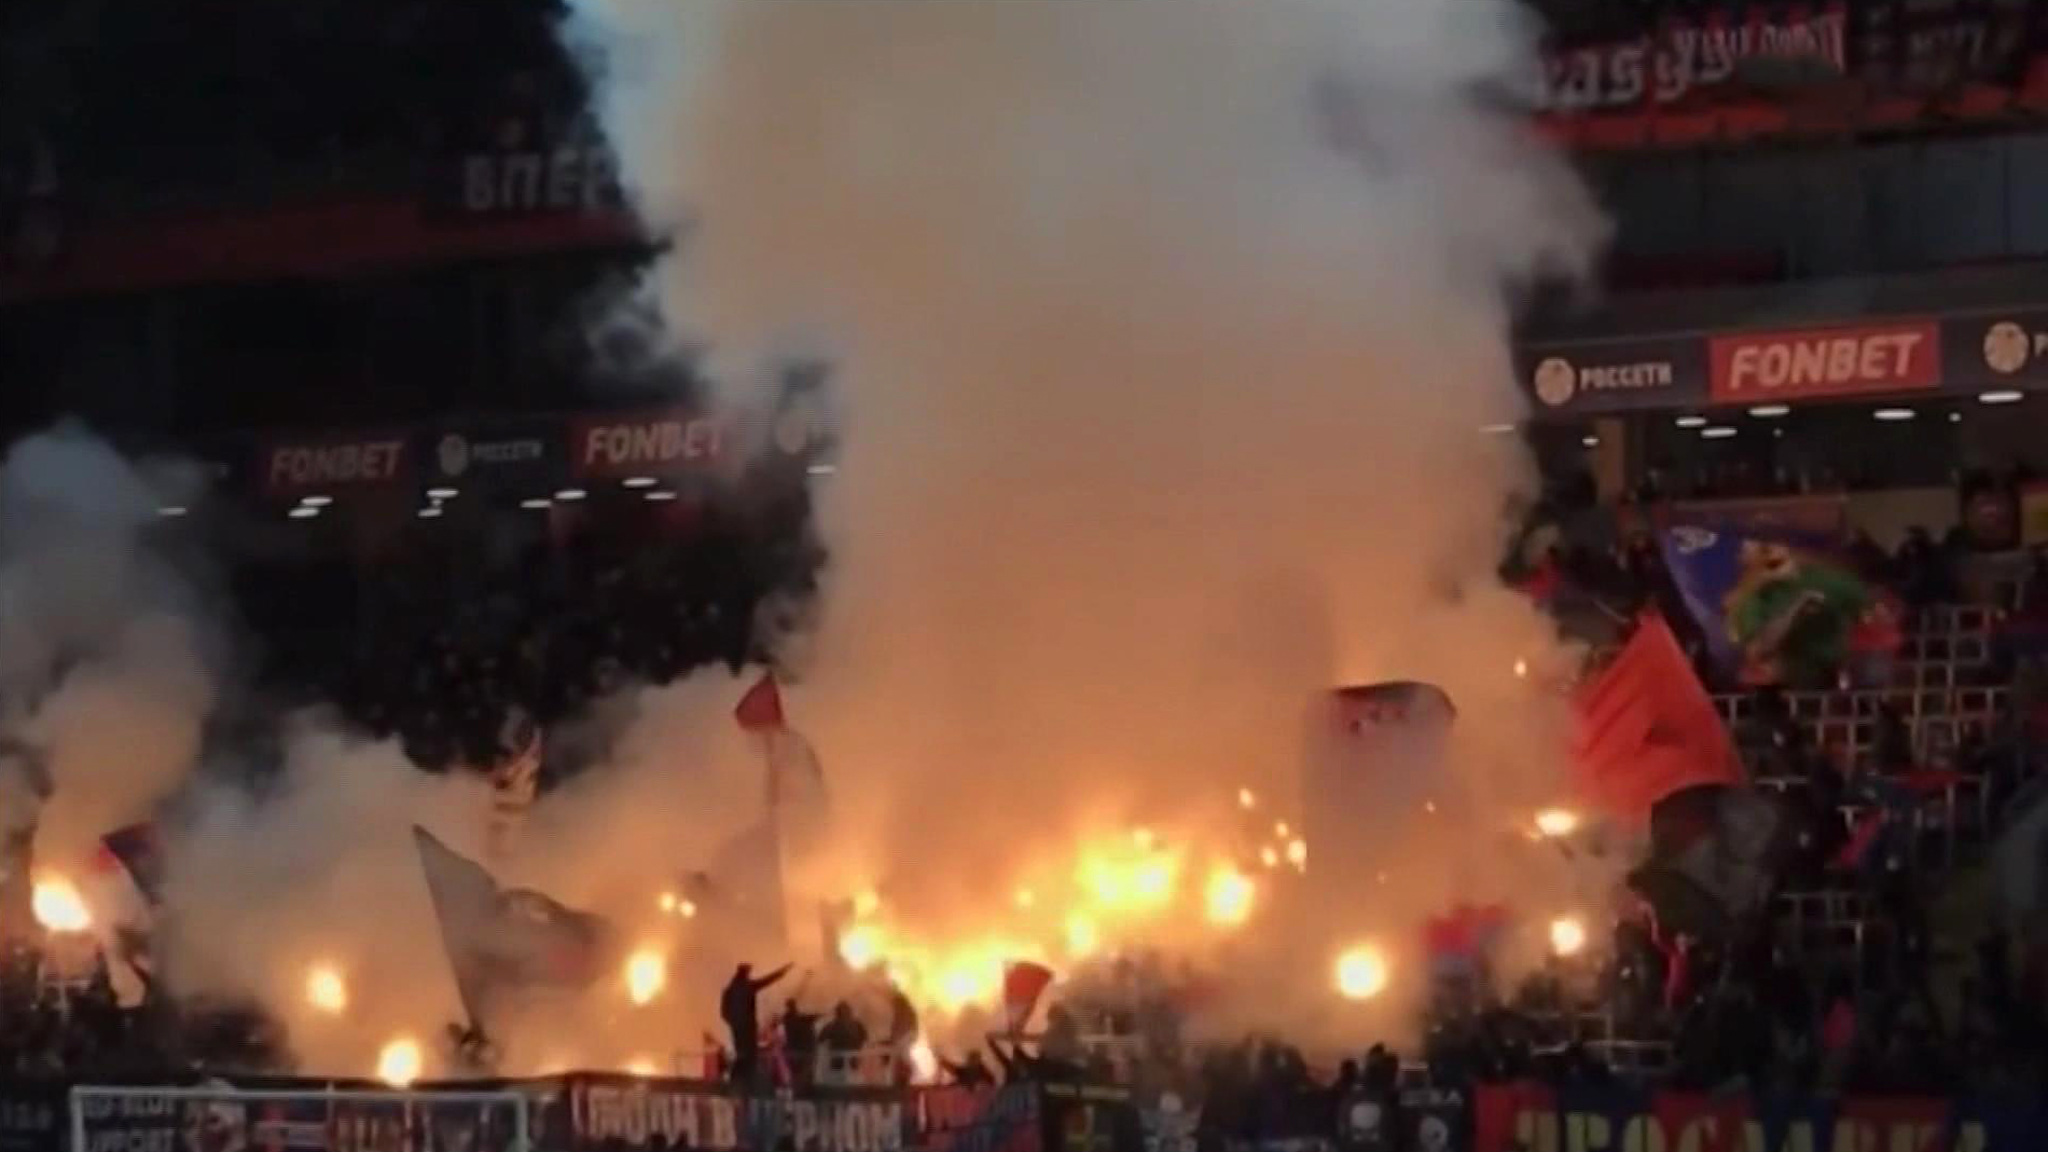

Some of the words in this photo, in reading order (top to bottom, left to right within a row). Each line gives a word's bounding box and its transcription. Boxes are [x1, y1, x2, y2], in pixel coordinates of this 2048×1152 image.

[1580, 362, 1673, 391] РОССЕТИ
[1729, 333, 1922, 390] FONBET
[270, 441, 405, 486] FONBET
[586, 419, 724, 465] FONBET
